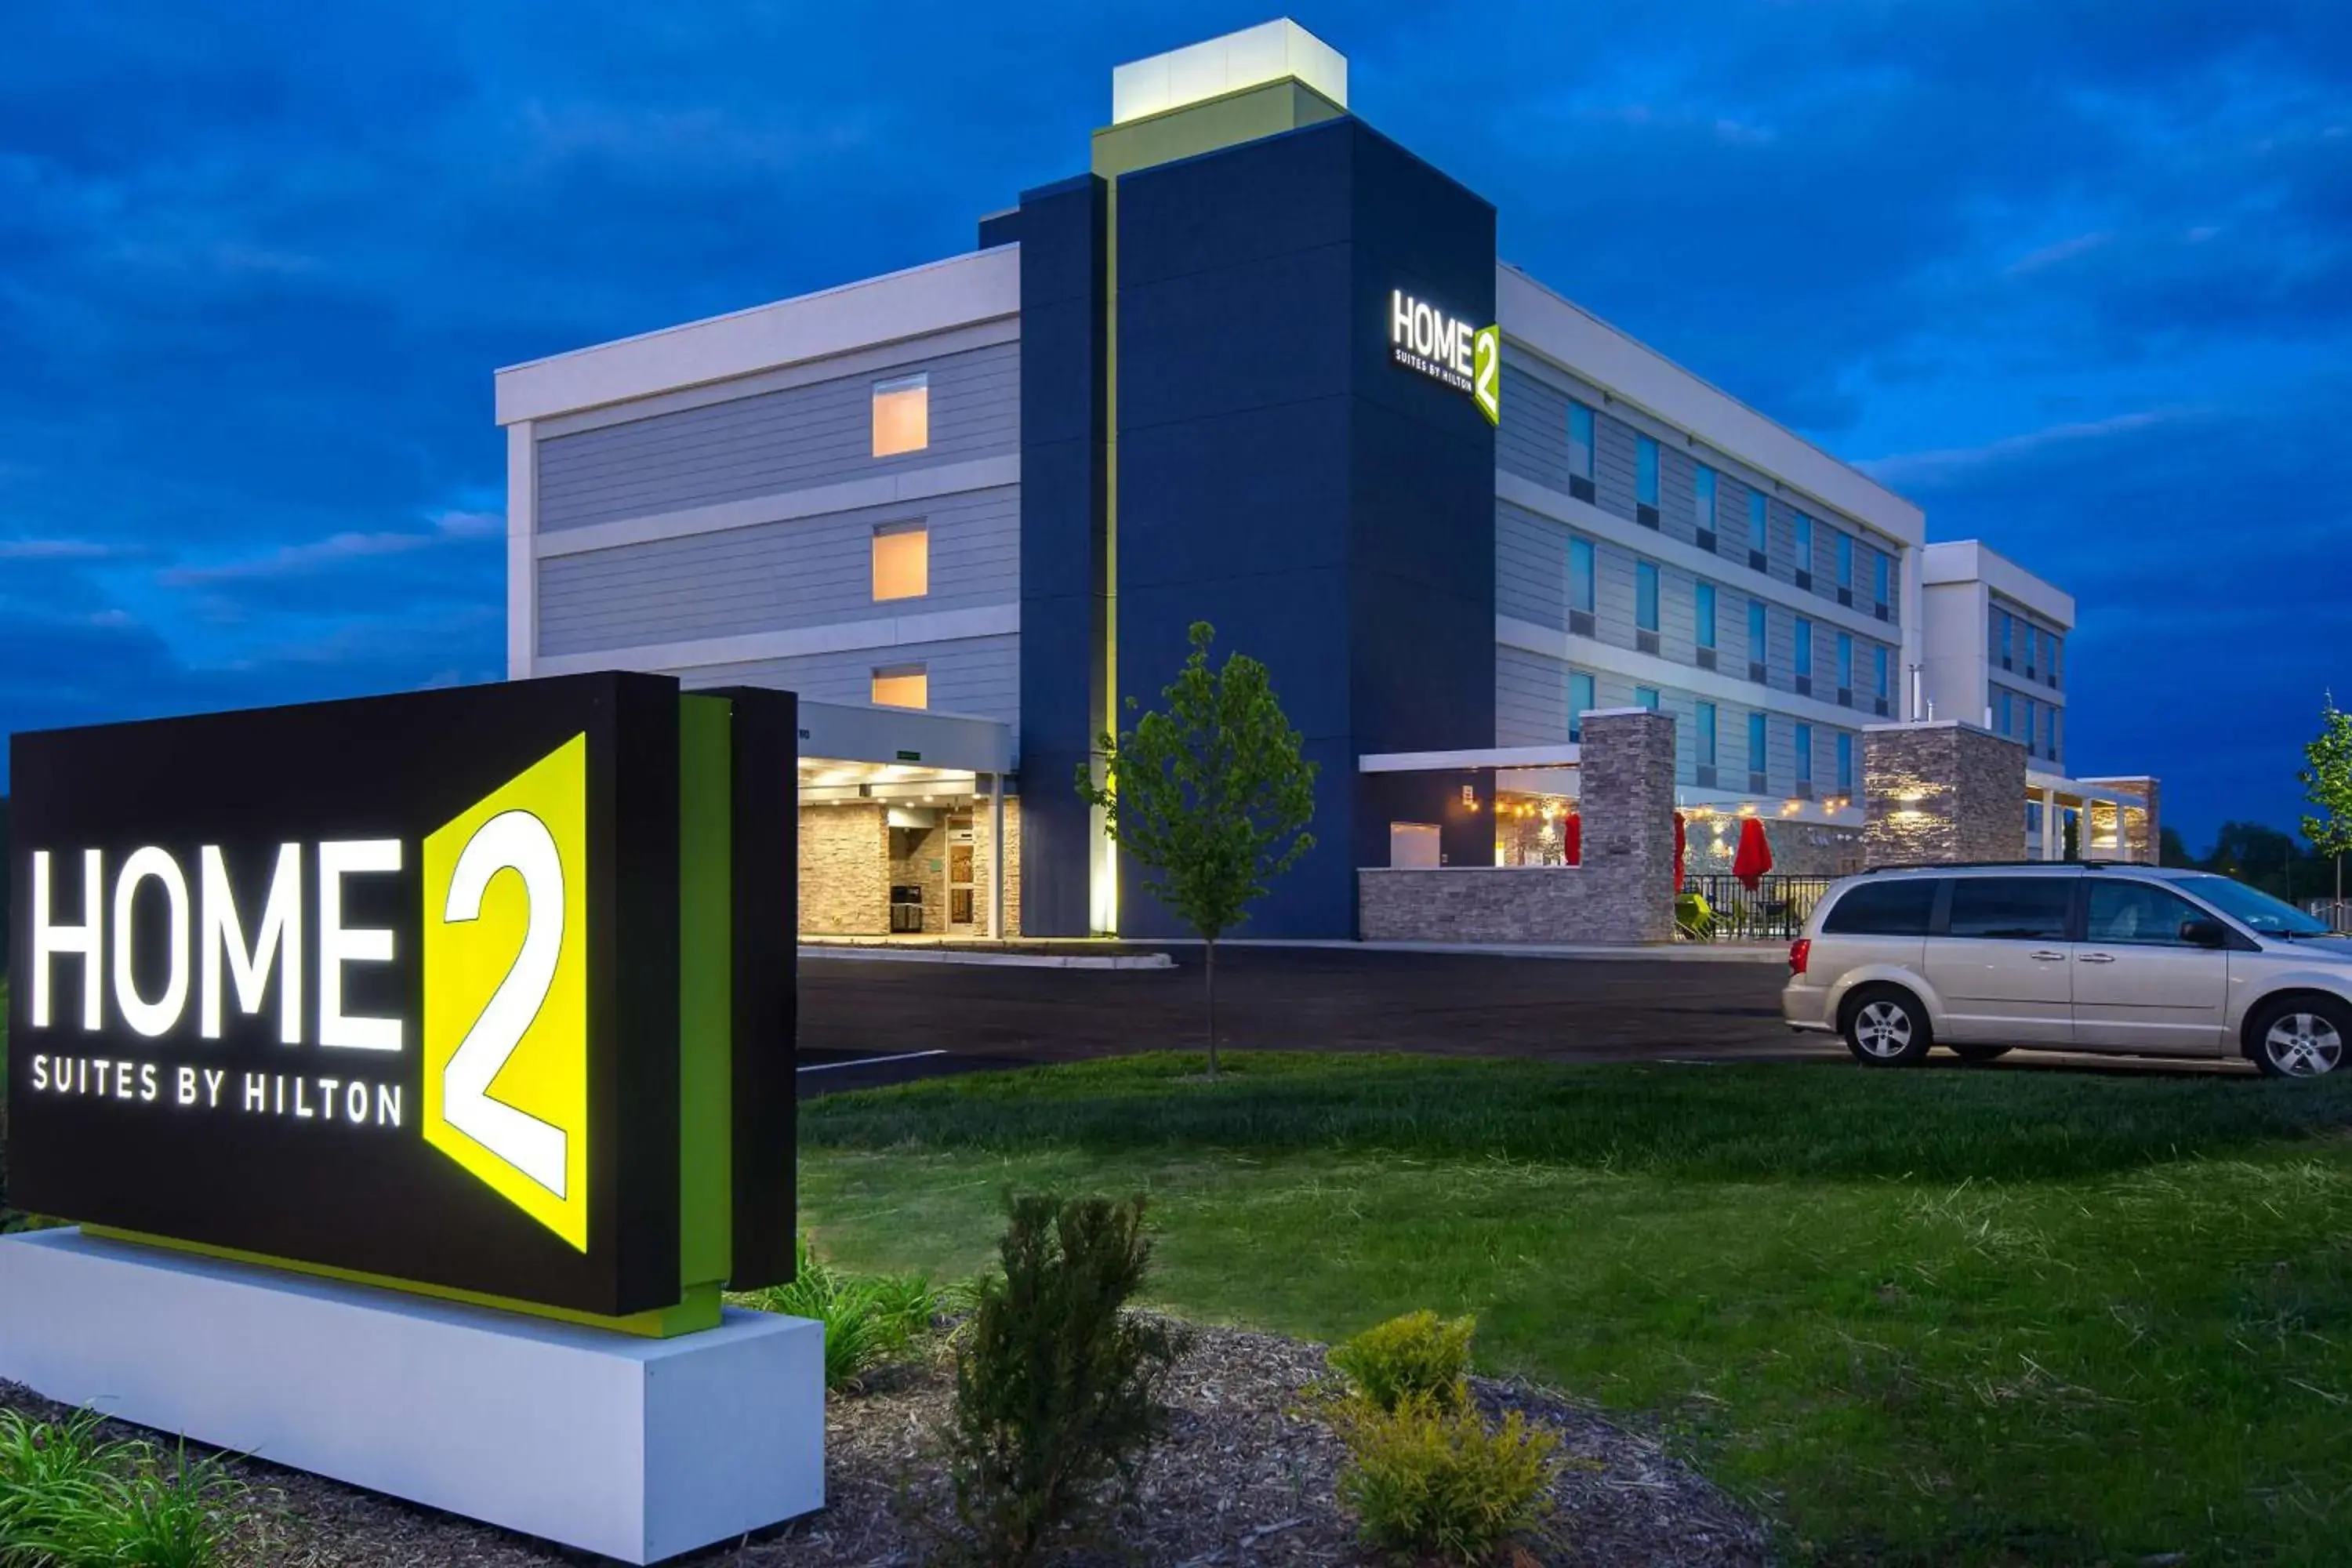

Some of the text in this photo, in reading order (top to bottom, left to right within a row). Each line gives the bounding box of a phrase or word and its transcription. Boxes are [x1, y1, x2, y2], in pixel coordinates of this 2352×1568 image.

[1393, 289, 1497, 414] HOME 2
[1395, 349, 1472, 391] SUITES BY HILTON
[33, 809, 568, 1201] HOME 2
[33, 1055, 401, 1127] SUITES BY HILTON
